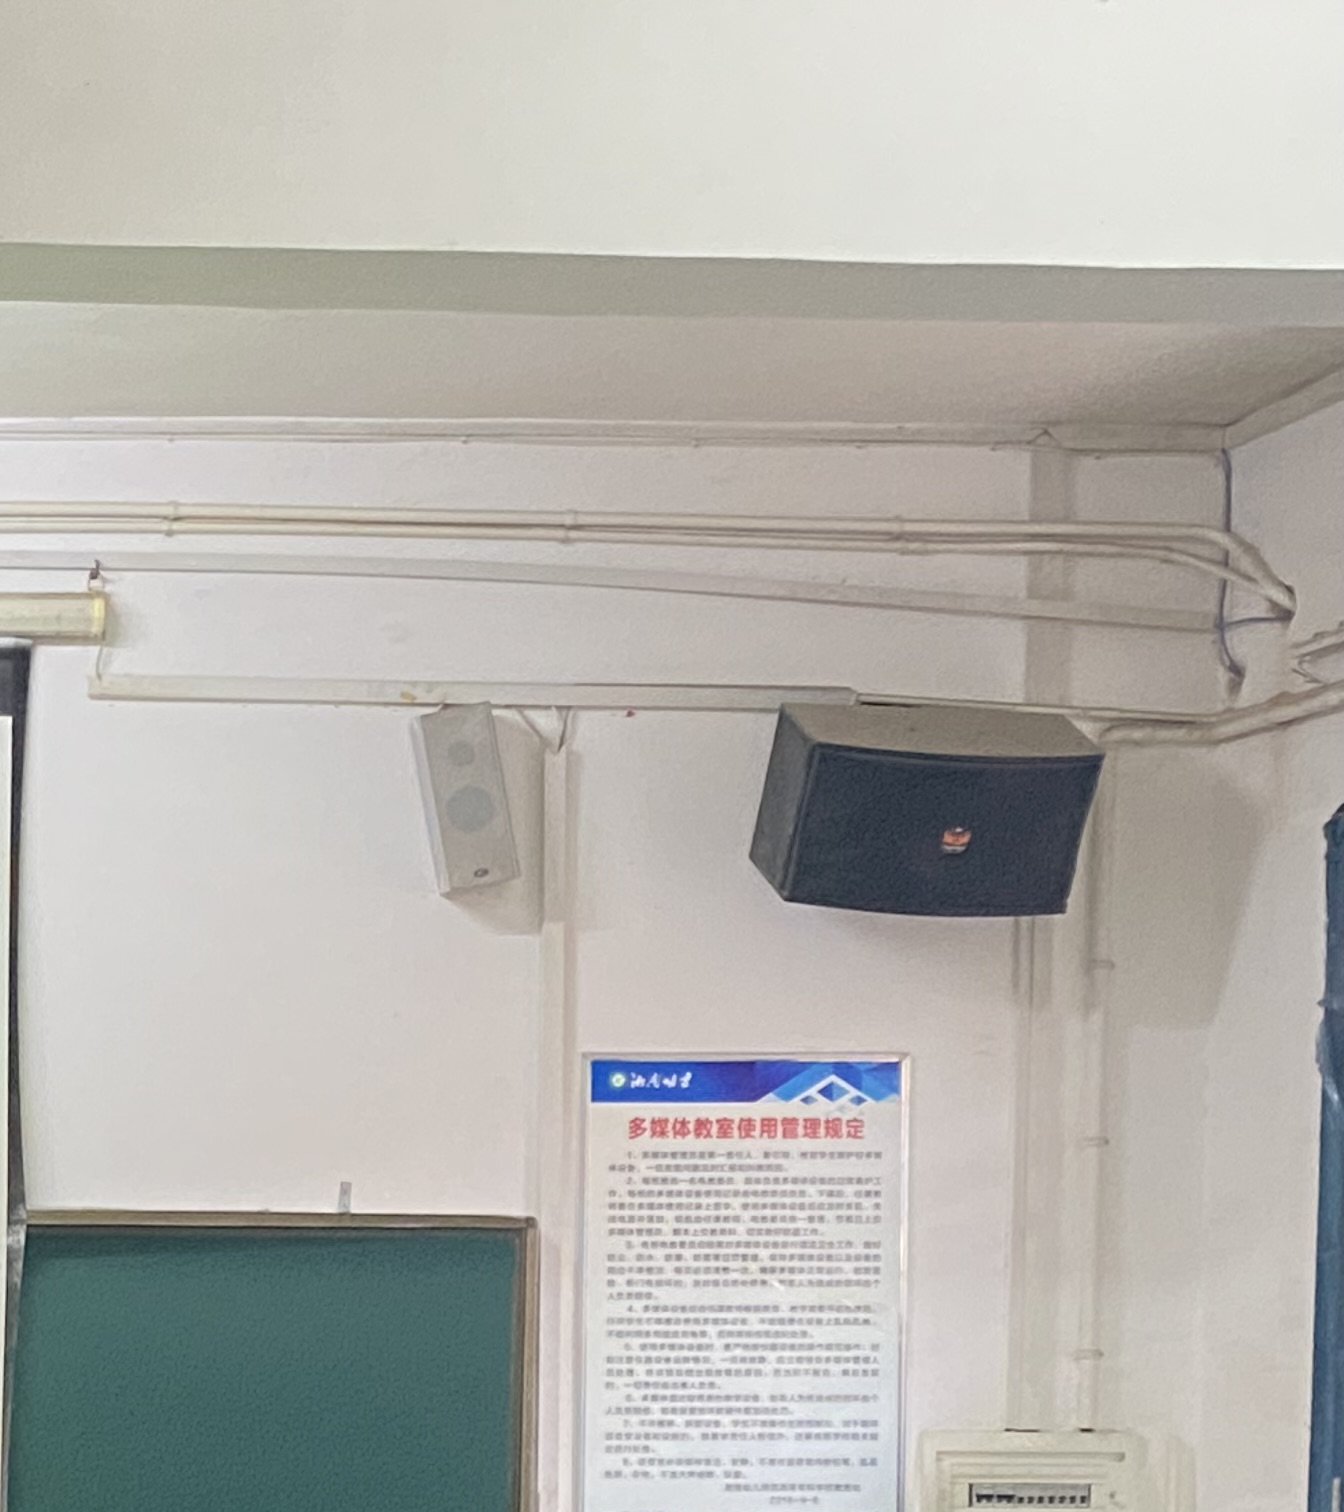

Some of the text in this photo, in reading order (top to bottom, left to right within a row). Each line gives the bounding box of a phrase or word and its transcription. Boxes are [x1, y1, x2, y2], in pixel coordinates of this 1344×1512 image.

[628, 1116, 865, 1140] 多媒体教室使用管理规定
